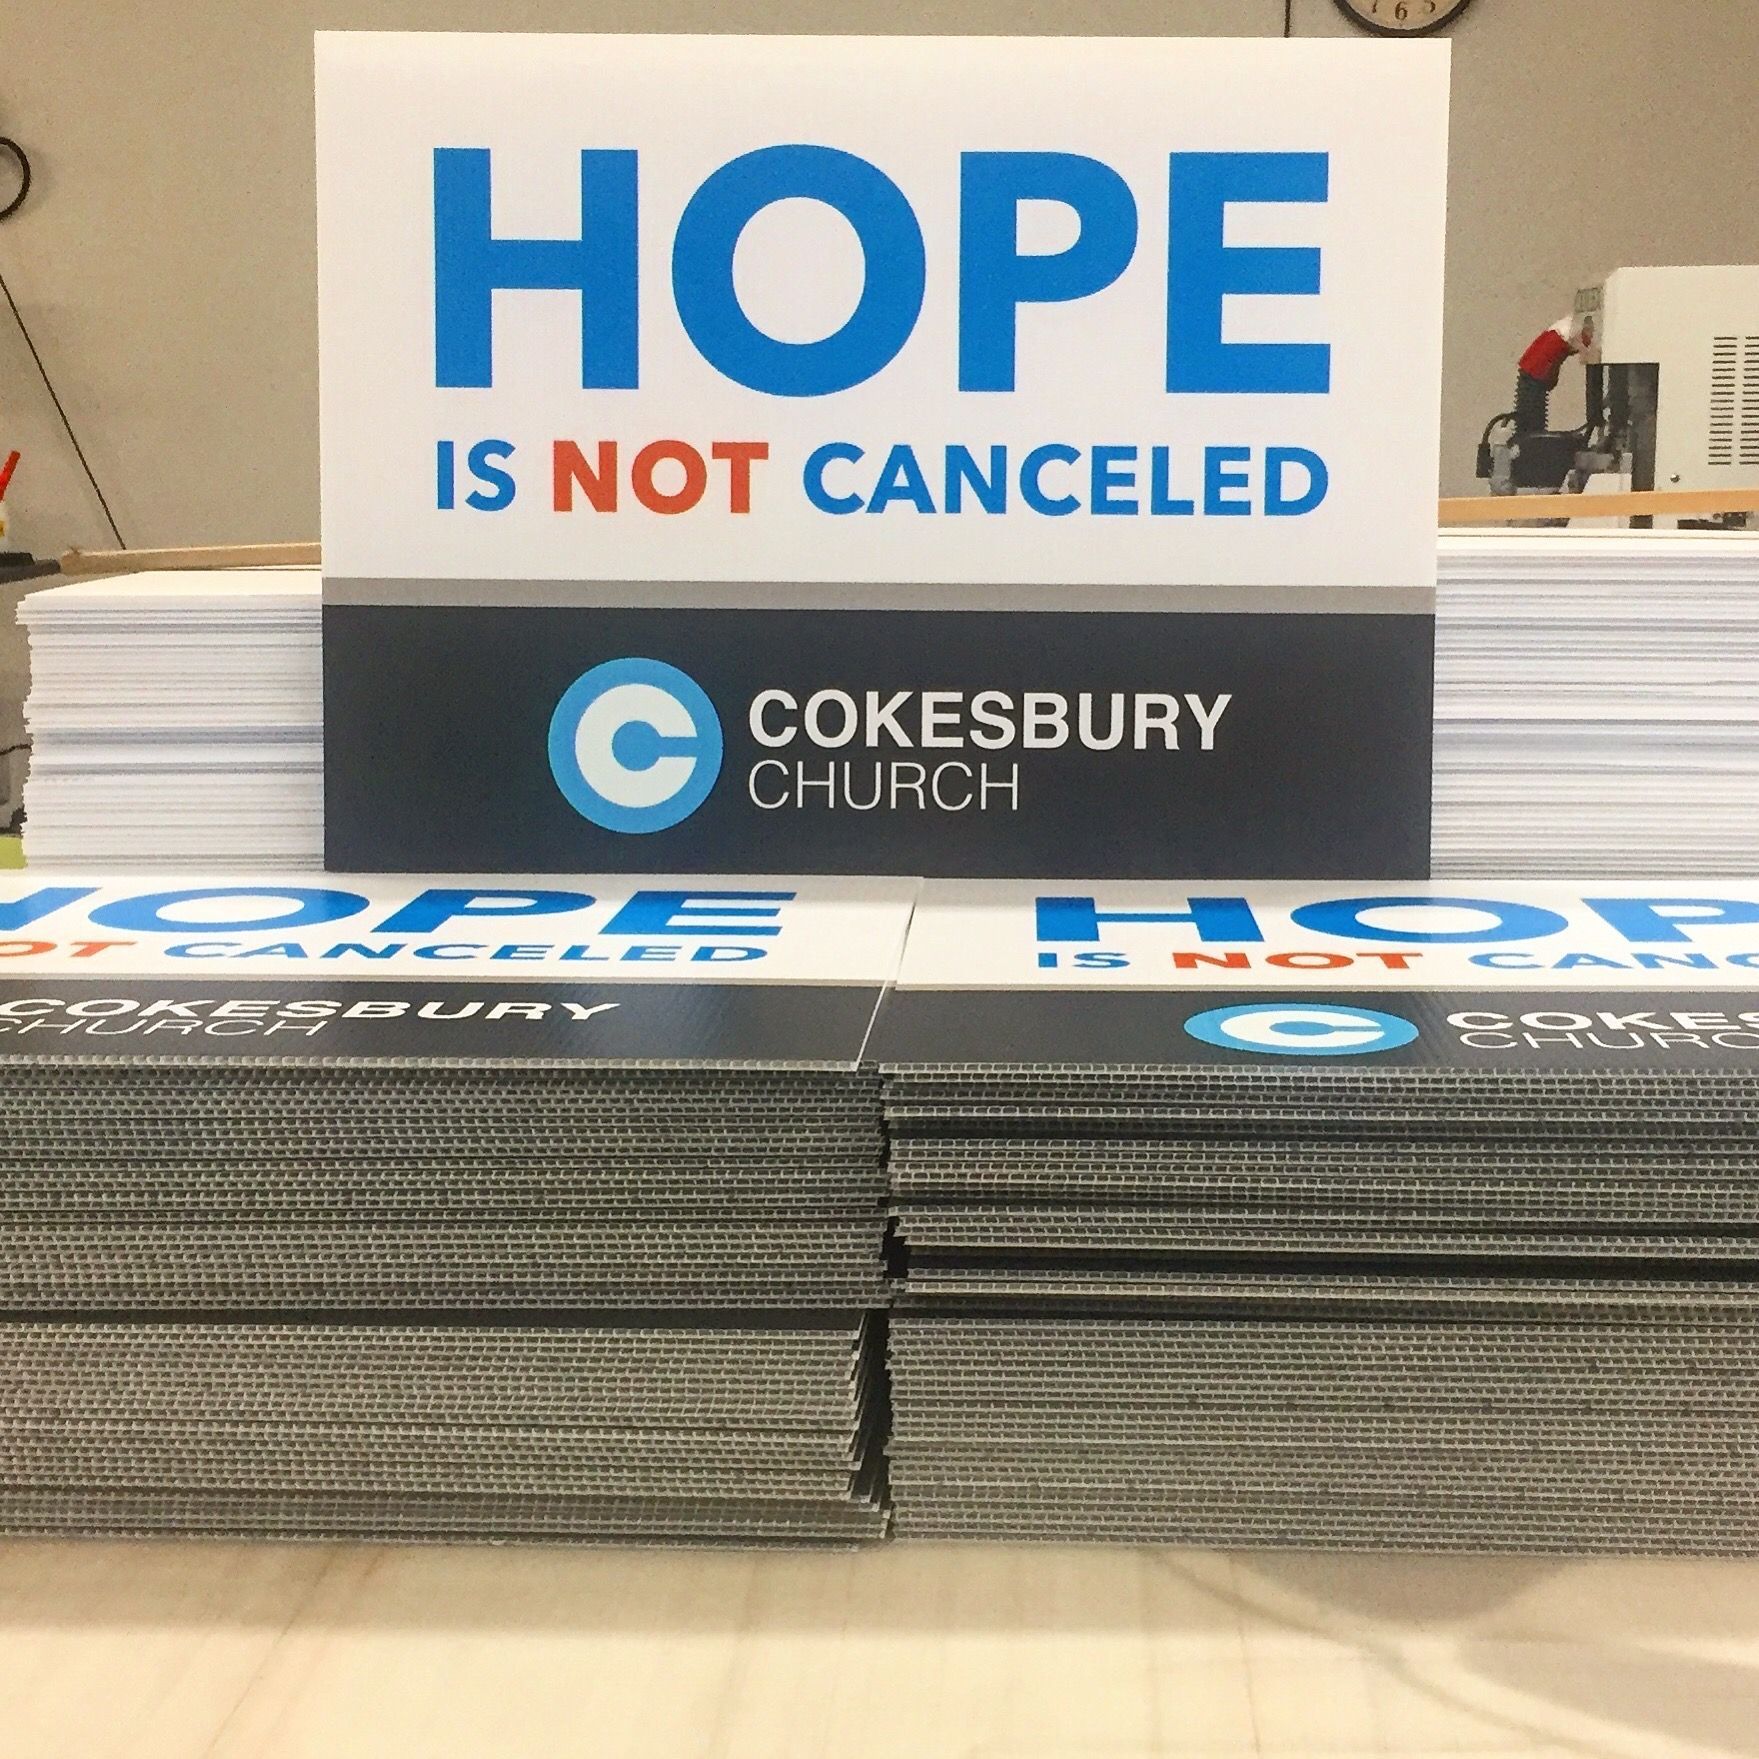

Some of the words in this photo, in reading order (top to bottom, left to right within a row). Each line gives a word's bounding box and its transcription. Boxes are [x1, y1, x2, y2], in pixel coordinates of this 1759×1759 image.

[1394, 2, 1408, 21] 6
[433, 143, 1331, 398] HOPE
[437, 439, 517, 513] IS
[553, 439, 769, 515] NOT
[803, 442, 1329, 517] CANCELED
[748, 688, 1232, 752] COKESBURY
[573, 682, 698, 810] C
[748, 759, 1019, 812] CHURCH
[1036, 896, 1759, 943] HOP
[164, 941, 767, 962] CANCELED
[1038, 952, 1130, 969] IS
[1172, 952, 1424, 970] NOT
[0, 998, 620, 1021] COKESBURY
[1459, 1031, 1759, 1050] CHURC
